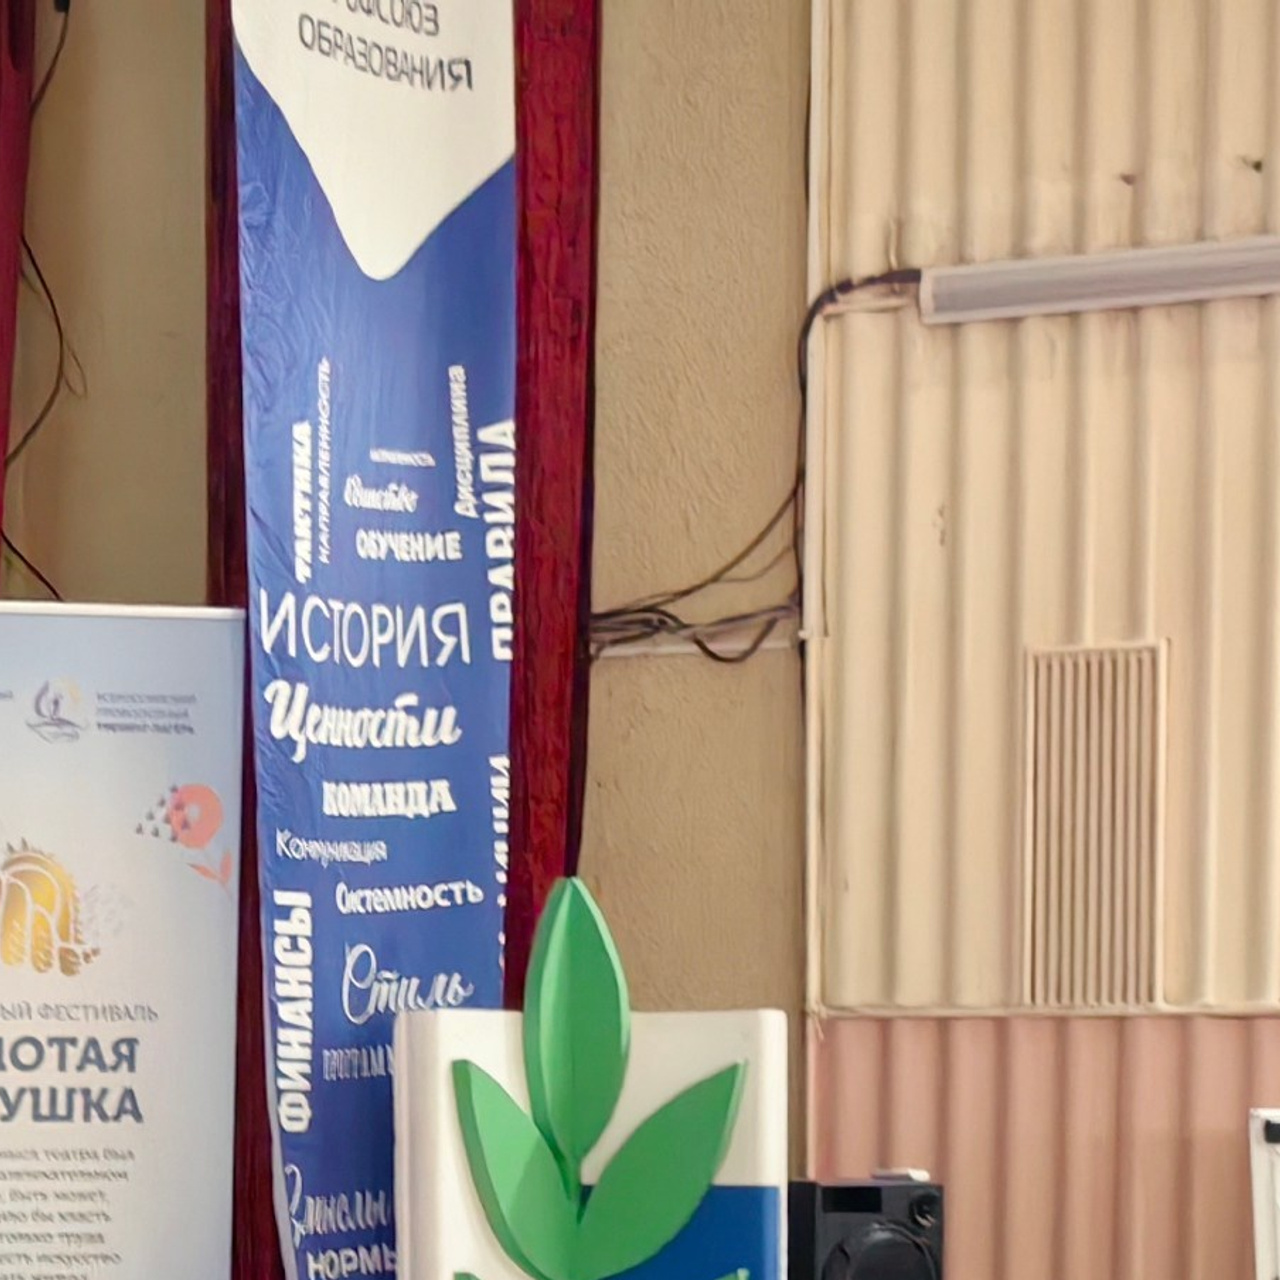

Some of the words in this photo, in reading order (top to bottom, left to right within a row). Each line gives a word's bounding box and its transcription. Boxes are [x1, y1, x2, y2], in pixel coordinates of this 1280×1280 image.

[299, 13, 473, 91] ОБРАЗОВАНИЯ
[292, 420, 312, 584] ТАКТИКА
[477, 420, 516, 661] ПРАВИЛА
[260, 587, 470, 668] ИСТОРИЯ
[264, 679, 462, 763] Ценности
[323, 779, 457, 818] КОМАНДА
[38, 1002, 159, 1022] ФЕСТИВАЛЬ
[273, 890, 313, 1132] ФИНАНСЫ
[341, 942, 474, 1025] Стиль
